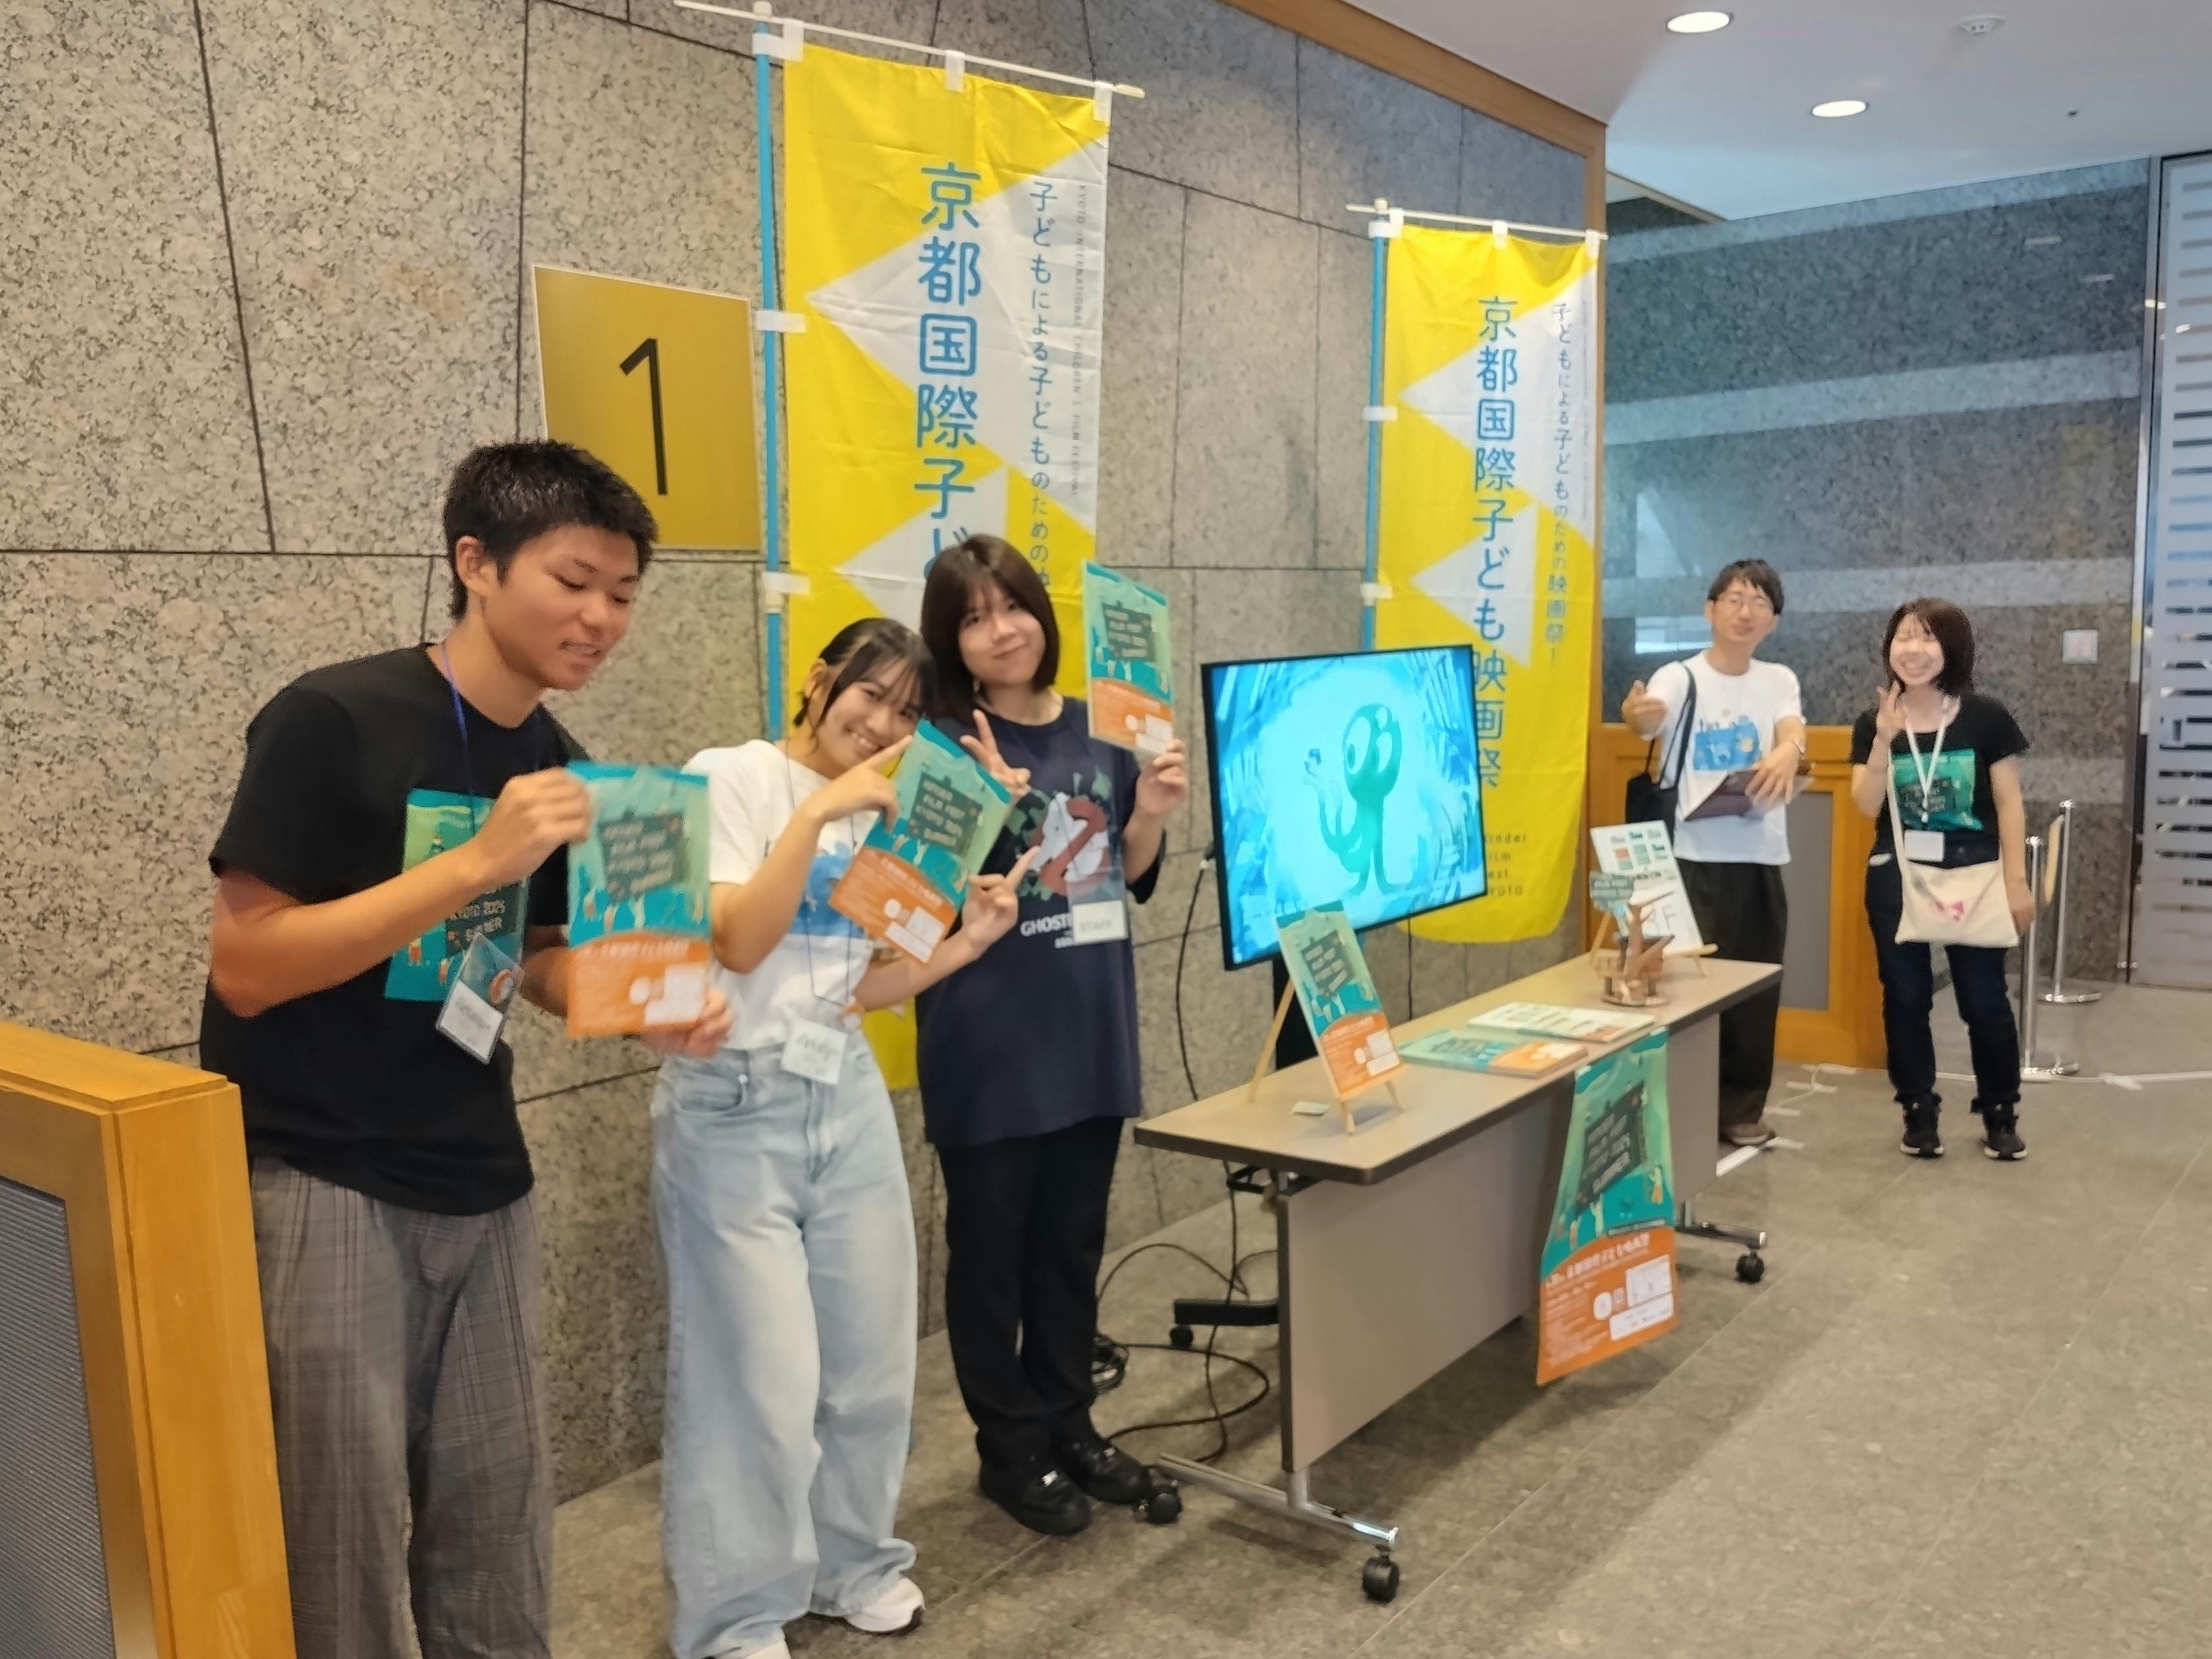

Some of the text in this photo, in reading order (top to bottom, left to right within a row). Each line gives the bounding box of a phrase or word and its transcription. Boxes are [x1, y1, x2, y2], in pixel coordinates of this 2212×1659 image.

[1076, 185, 1087, 225] KYOTO
[1029, 181, 1057, 586] 子どもによる子どものための
[619, 337, 668, 495] 1
[1484, 832, 1526, 844] inder
[1488, 868, 1508, 878] est
[1489, 885, 1524, 897] YOTO
